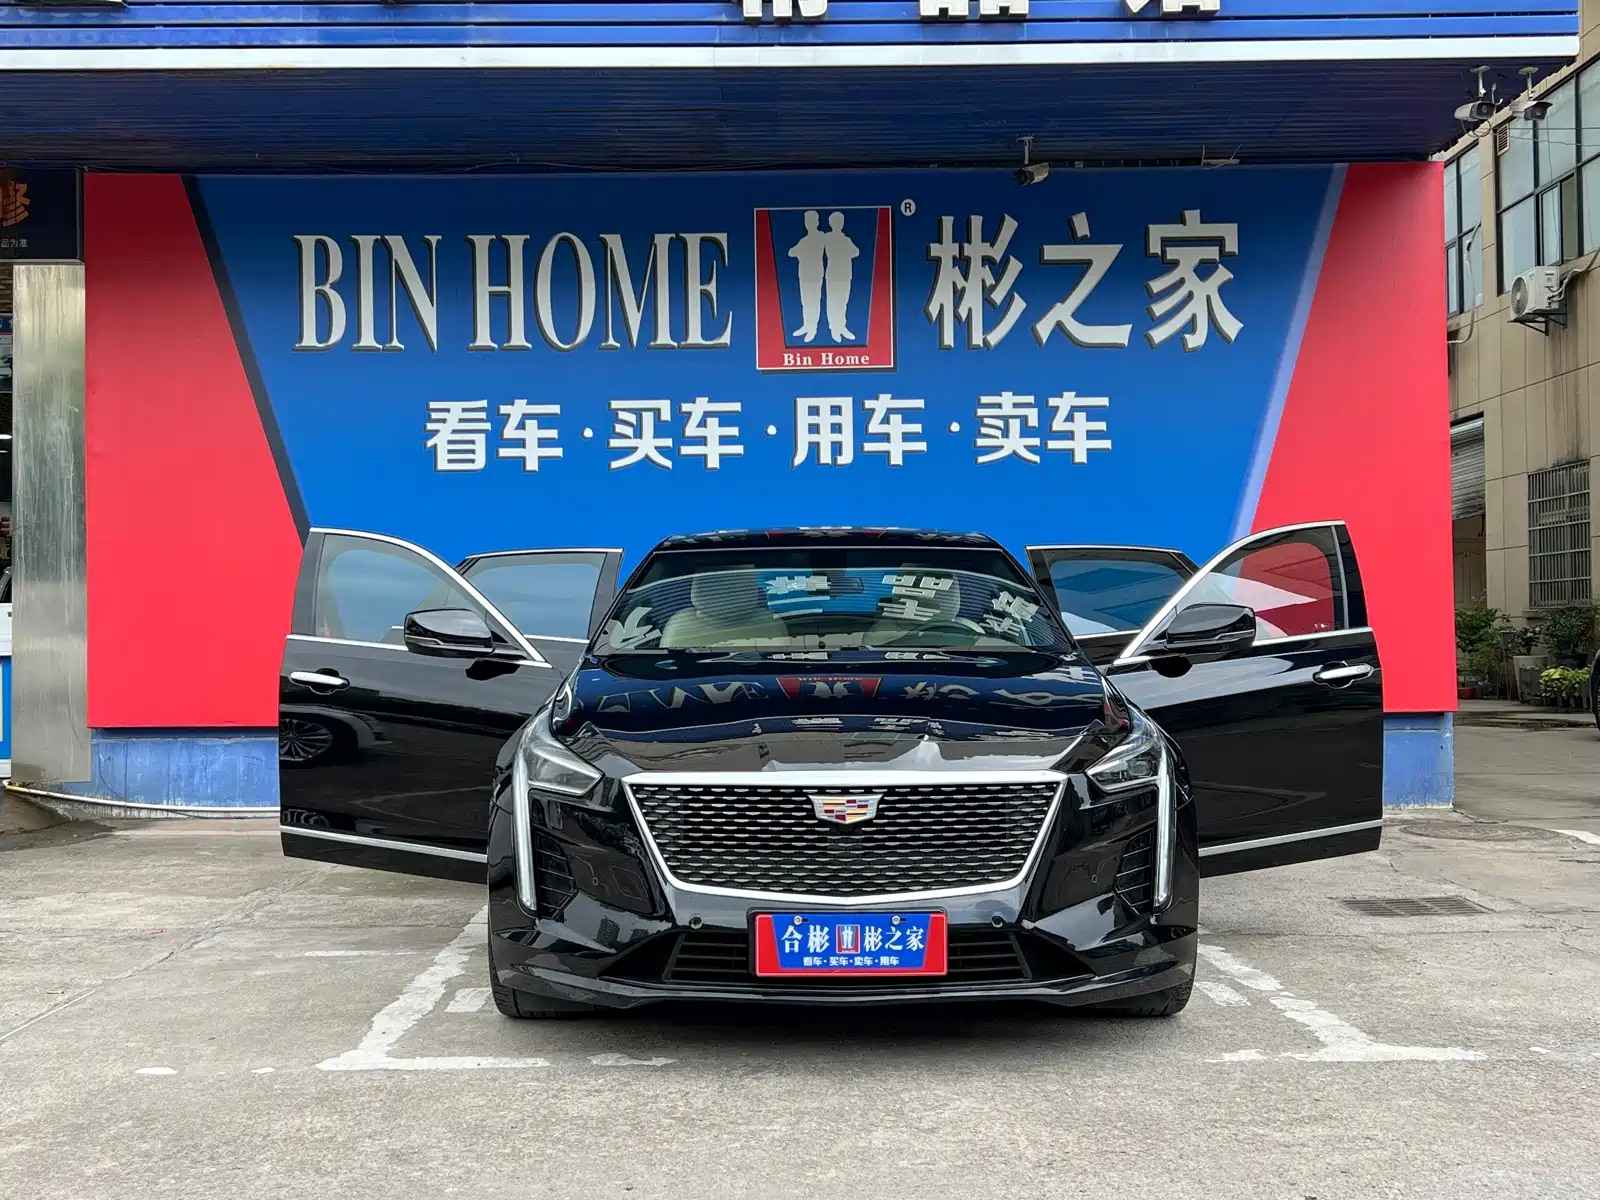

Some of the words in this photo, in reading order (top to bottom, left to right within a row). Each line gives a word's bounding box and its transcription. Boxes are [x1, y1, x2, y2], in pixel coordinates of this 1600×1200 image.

[293, 234, 441, 352] BIN
[466, 231, 733, 352] HOME
[924, 209, 1245, 352] 彬之家
[782, 353, 813, 367] Bin
[820, 352, 871, 366] Home
[781, 924, 831, 954] 合彬
[863, 925, 925, 953] 彬之家
